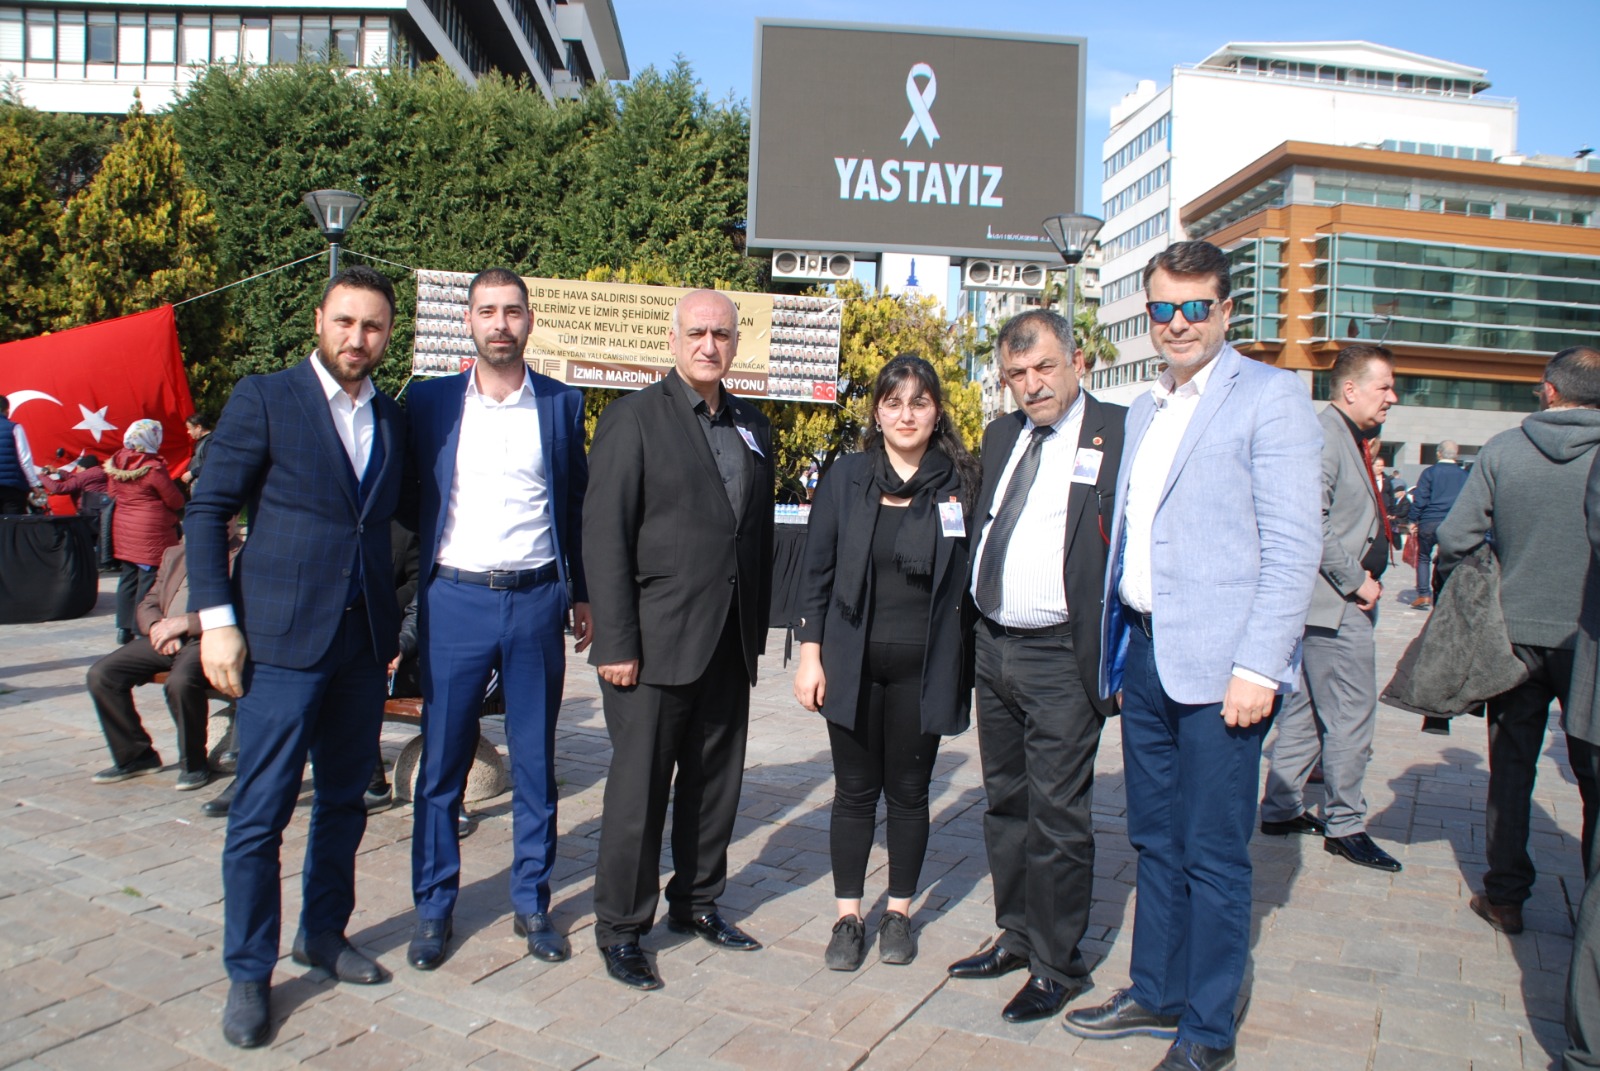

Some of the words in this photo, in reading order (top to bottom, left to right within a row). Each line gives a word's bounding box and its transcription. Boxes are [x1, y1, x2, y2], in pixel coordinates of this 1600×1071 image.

[833, 157, 1003, 207] YASTAYIZ
[528, 286, 560, 299] LİB'DE
[563, 290, 588, 300] HAVA
[591, 292, 638, 303] SALDIRISI
[579, 306, 591, 315] VE
[594, 305, 619, 317] İZMİR
[622, 308, 670, 321] ŞEHİDİMİZ
[537, 318, 591, 331] OKUNACAK
[594, 321, 628, 333] MEVLİT
[631, 324, 644, 334] VE
[646, 326, 673, 335] KUR'
[558, 333, 578, 345] TÜM
[581, 333, 606, 346] İZMİR
[609, 338, 637, 348] HALKI
[532, 348, 555, 356] KONAK
[557, 350, 586, 358] MEYDANI
[603, 353, 638, 362] CAMİSİNDE
[573, 365, 603, 380] İZMİR
[605, 369, 667, 384] MARDİNLİ
